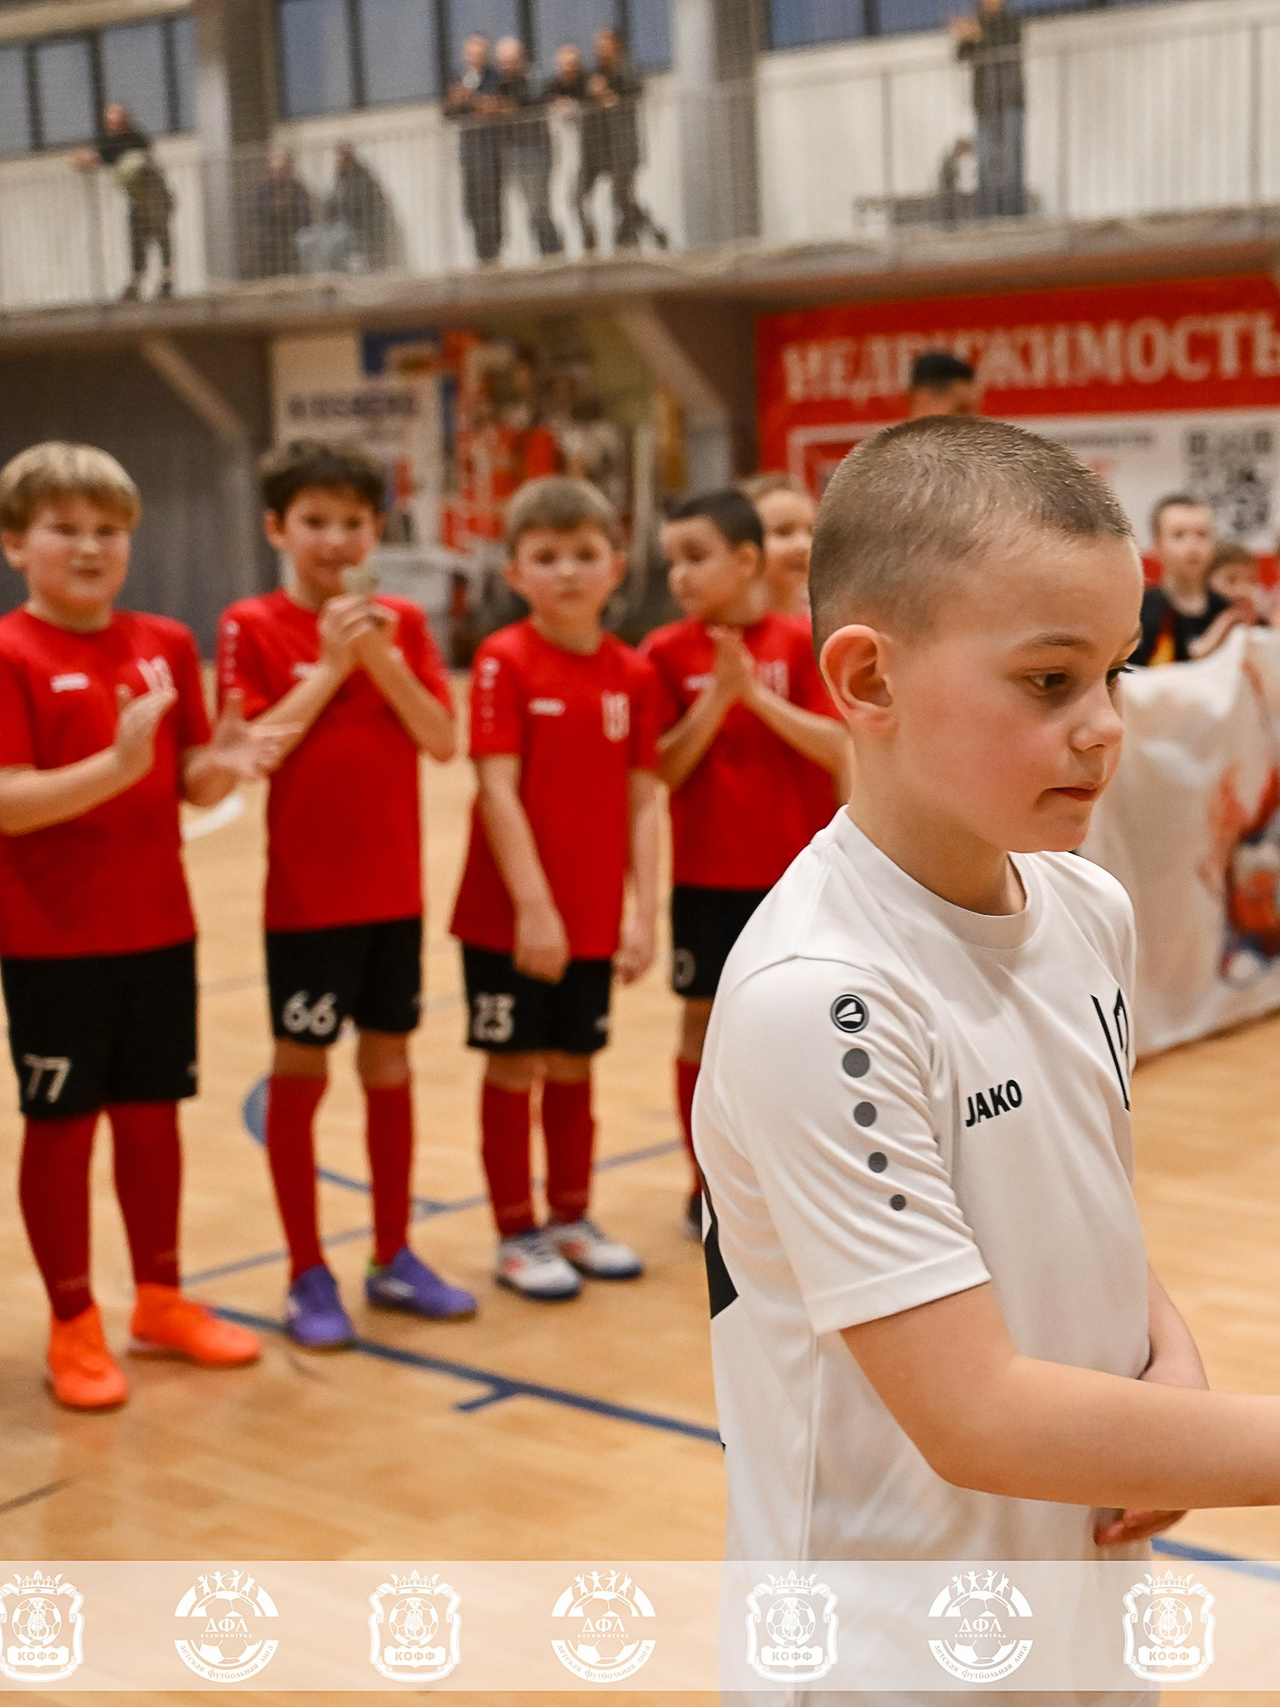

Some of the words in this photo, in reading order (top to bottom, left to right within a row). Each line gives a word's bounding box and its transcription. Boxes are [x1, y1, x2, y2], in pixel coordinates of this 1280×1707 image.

[282, 989, 338, 1036] 66
[23, 1053, 72, 1103] 77
[965, 1079, 1023, 1128] JAKO
